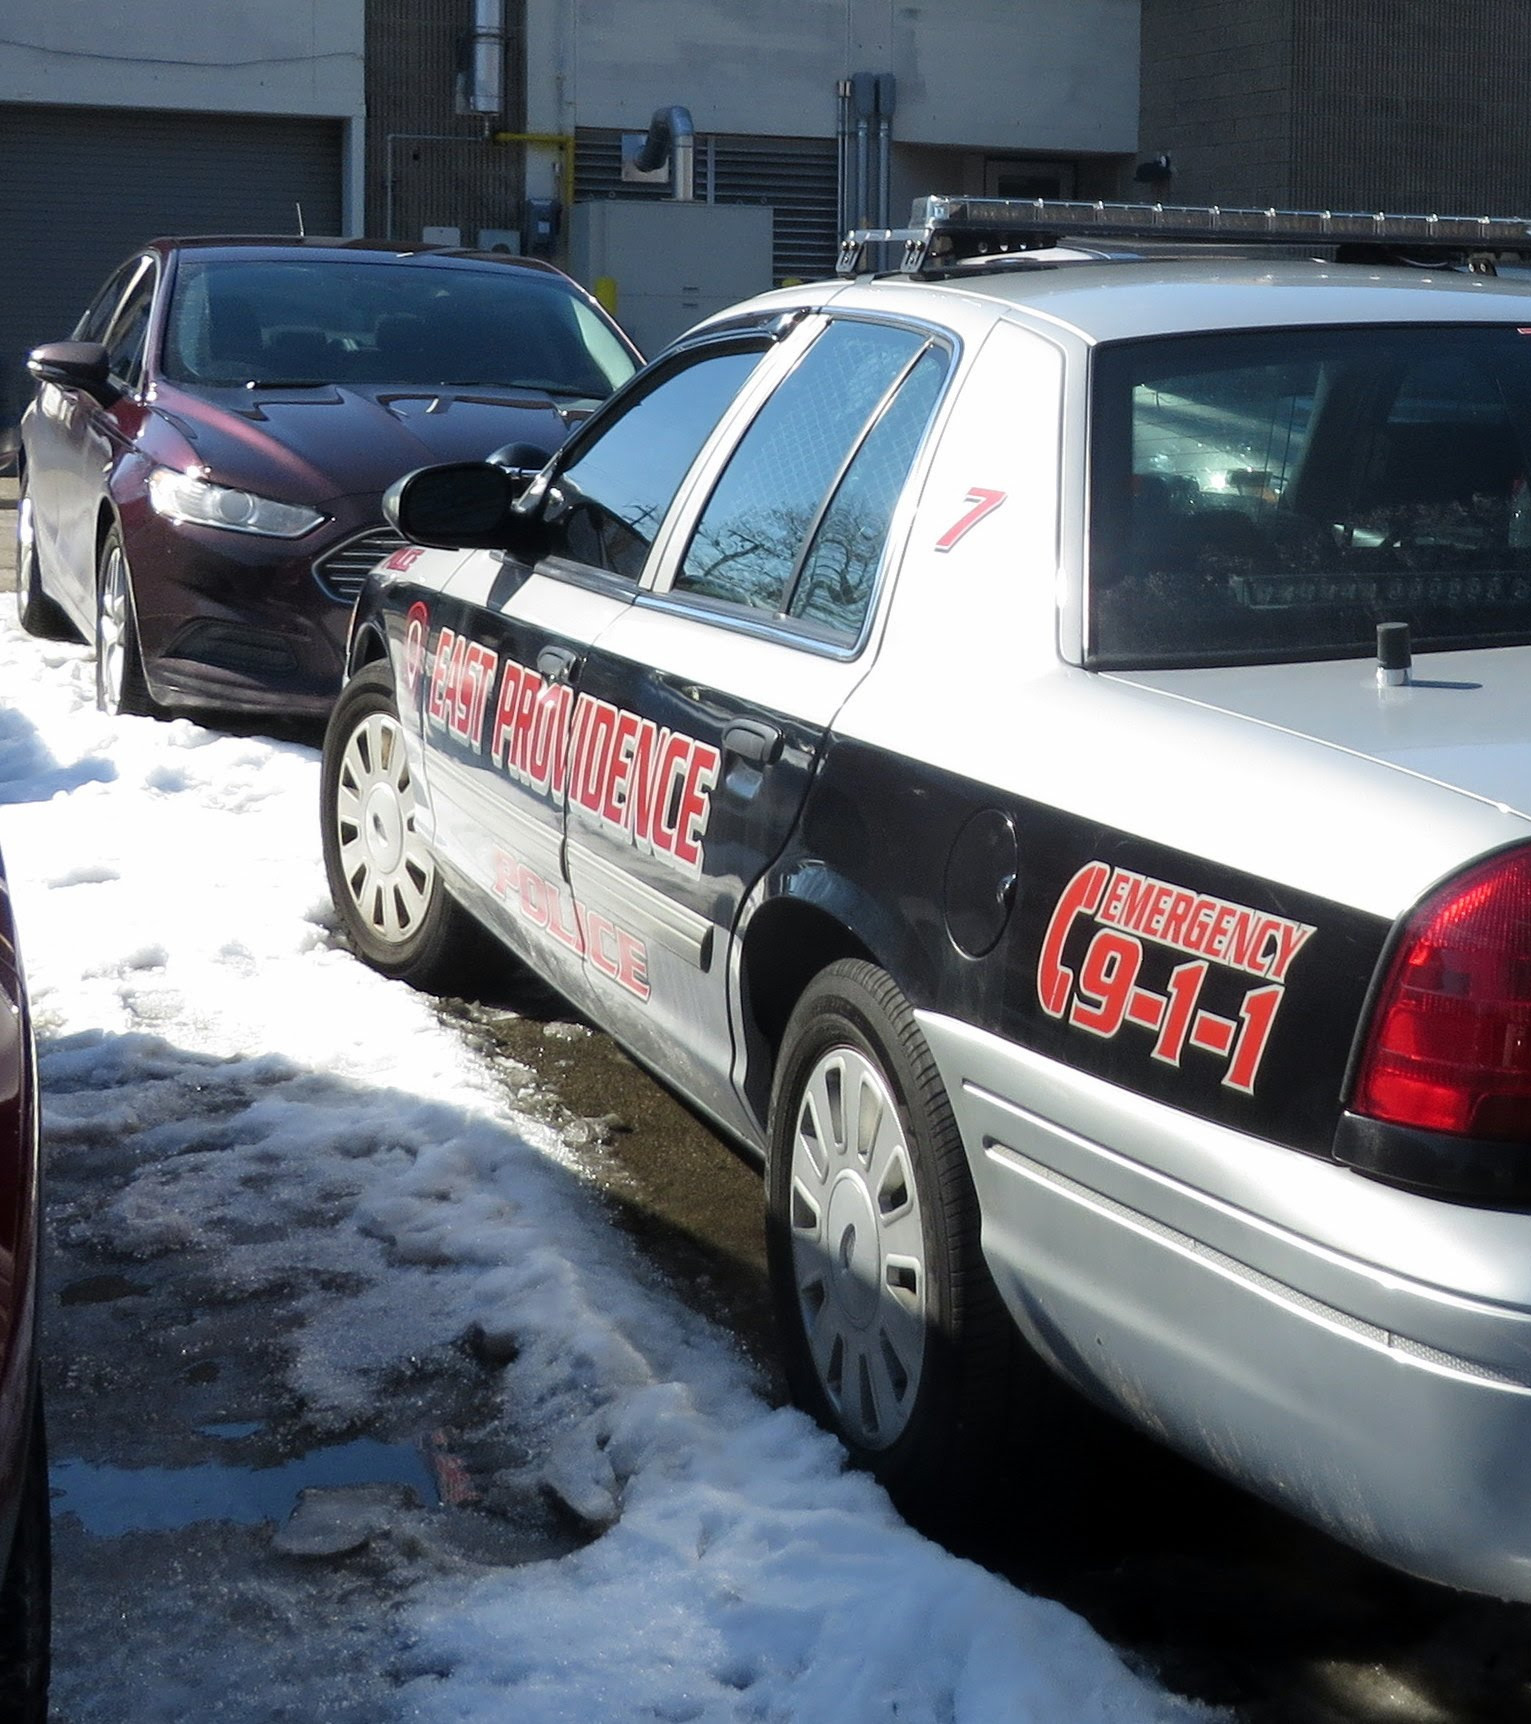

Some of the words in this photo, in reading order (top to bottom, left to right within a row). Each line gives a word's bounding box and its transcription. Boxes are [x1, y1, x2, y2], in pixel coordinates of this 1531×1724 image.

[934, 486, 1008, 553] 7
[429, 626, 499, 755] EAST
[492, 658, 722, 881] PROVIDENCE
[490, 846, 652, 1002] POLICE
[1094, 866, 1318, 985] EMERGENCY
[1069, 927, 1286, 1096] 9-1-1
